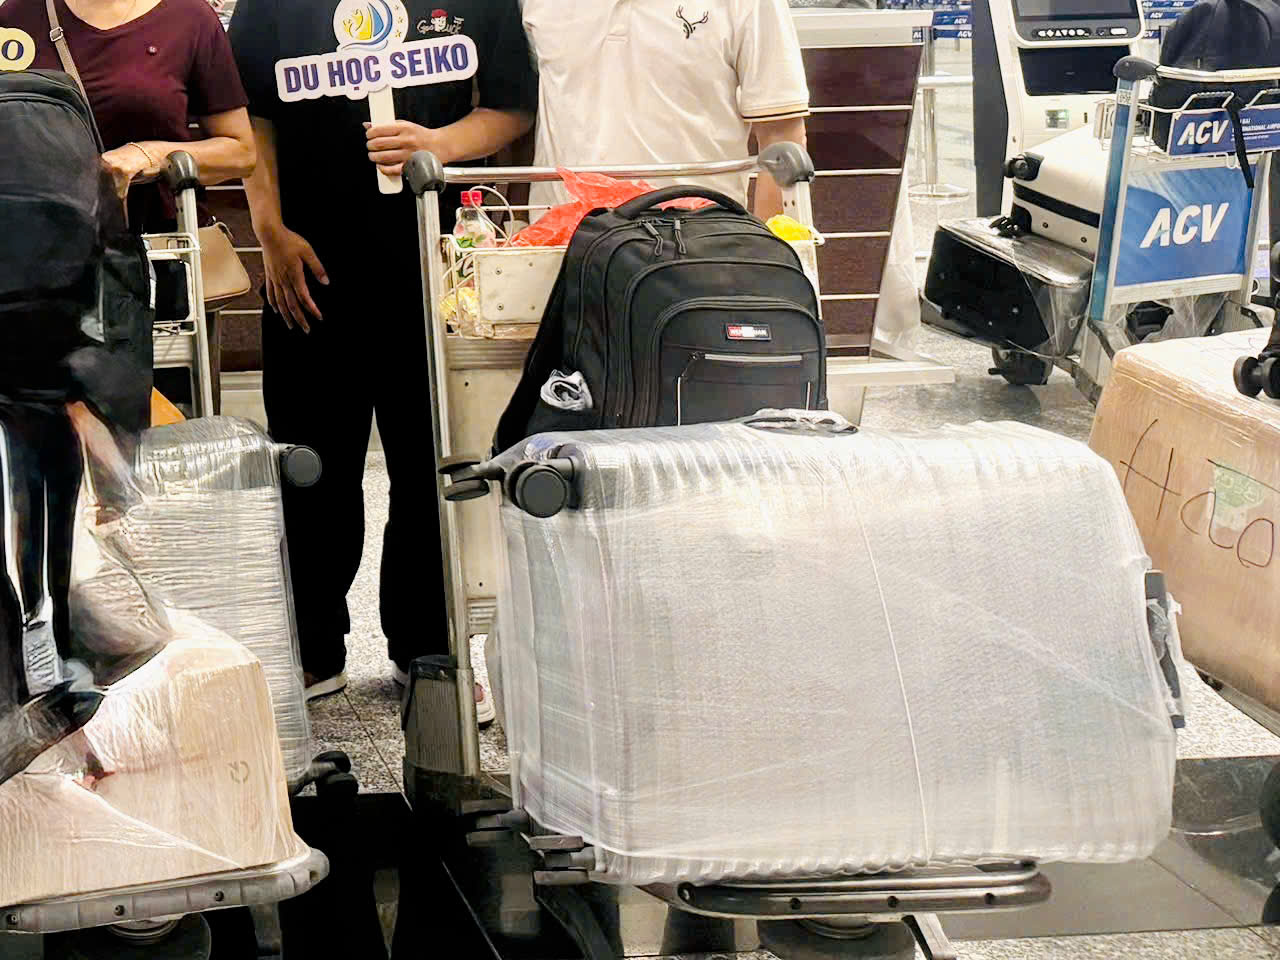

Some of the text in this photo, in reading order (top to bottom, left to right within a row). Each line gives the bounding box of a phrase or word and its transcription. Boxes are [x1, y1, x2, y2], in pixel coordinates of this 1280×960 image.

[283, 42, 470, 94] DU HỌC SEIKO
[1177, 120, 1229, 146] ACV
[1140, 202, 1230, 248] ACV
